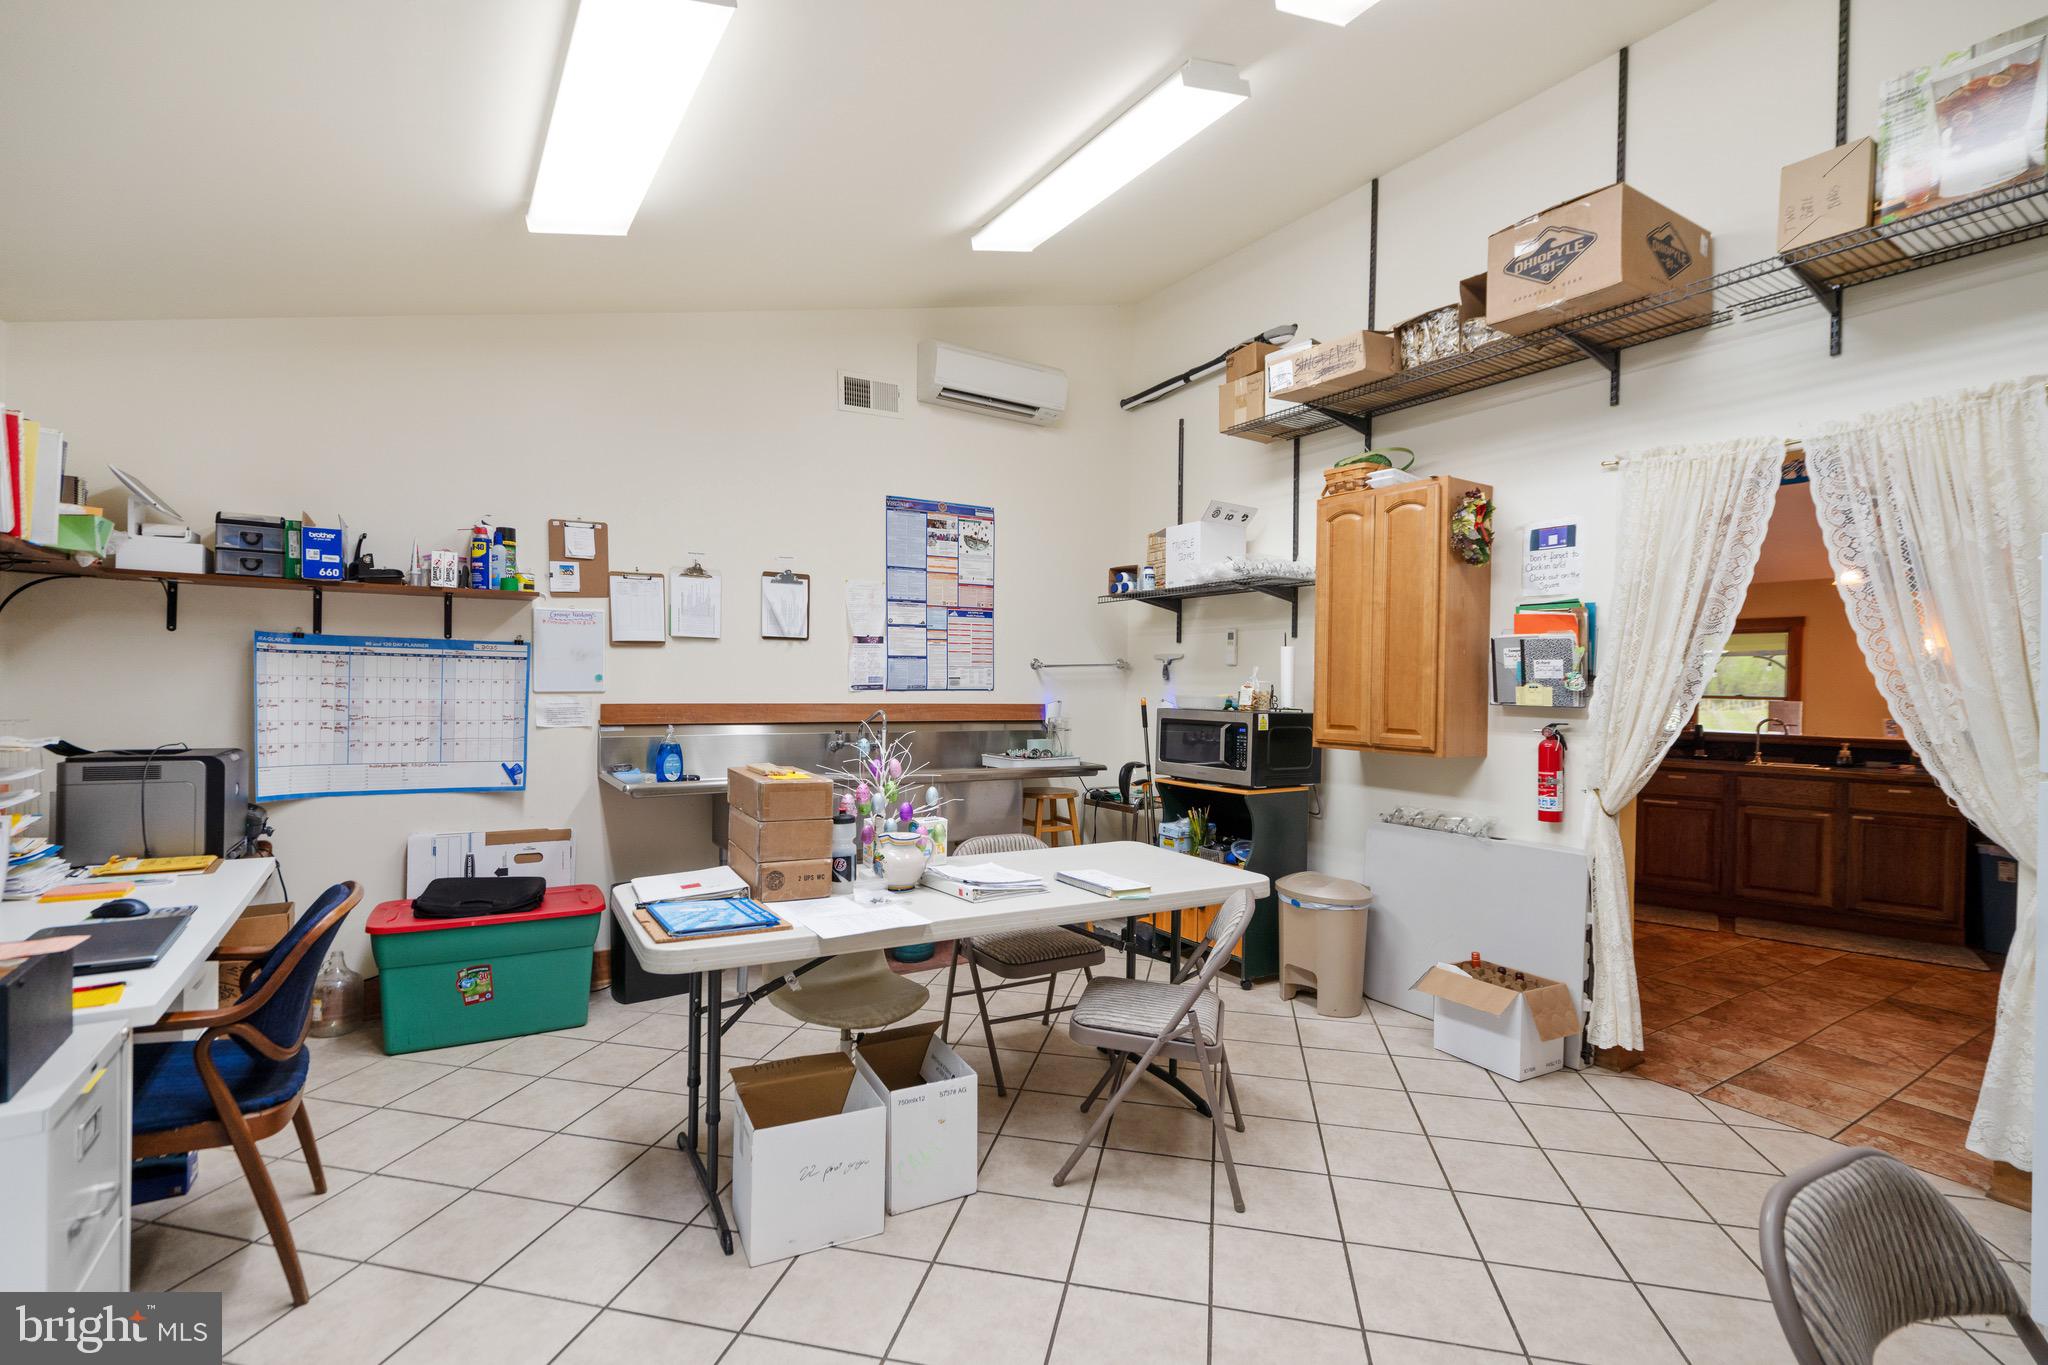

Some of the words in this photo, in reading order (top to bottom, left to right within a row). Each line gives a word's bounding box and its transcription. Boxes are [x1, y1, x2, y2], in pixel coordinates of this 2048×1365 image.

[1514, 238, 1585, 275] OHIOPYLE
[308, 531, 336, 539] brother
[319, 568, 340, 577] 660
